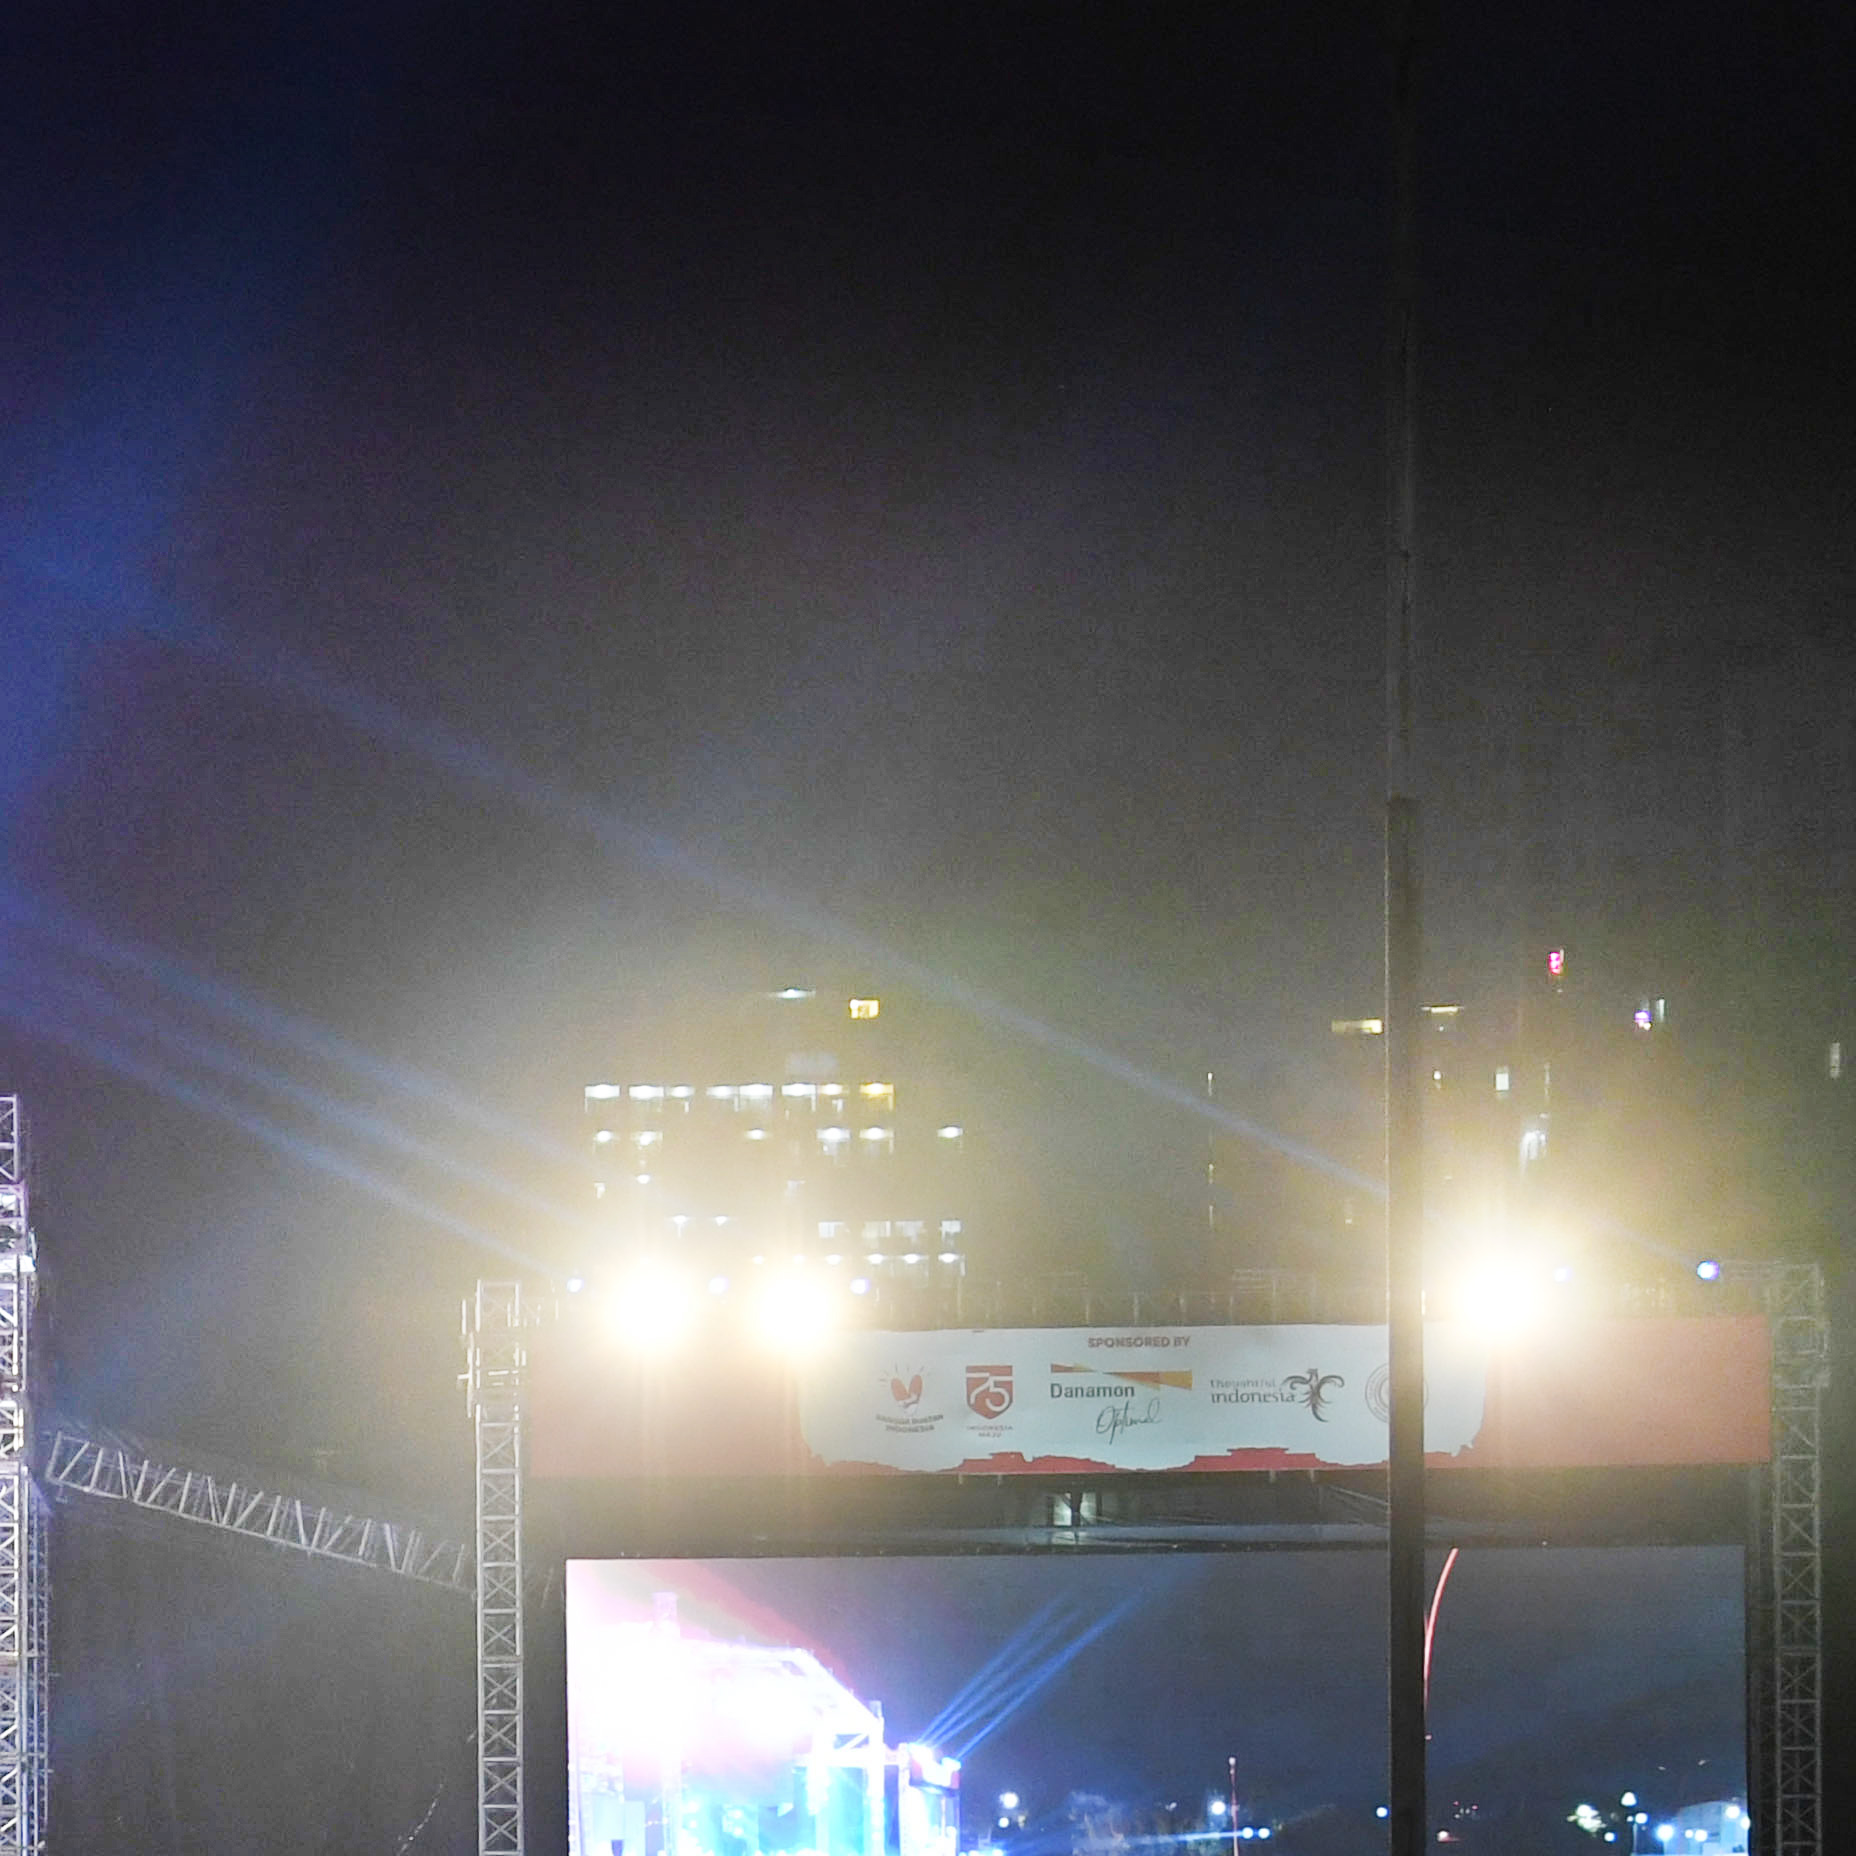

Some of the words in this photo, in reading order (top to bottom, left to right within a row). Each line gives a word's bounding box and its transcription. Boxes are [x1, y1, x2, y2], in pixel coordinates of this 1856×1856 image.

[1088, 1336, 1170, 1348] SPONSORED
[1174, 1336, 1191, 1348] BY
[1051, 1383, 1135, 1399] Danamon
